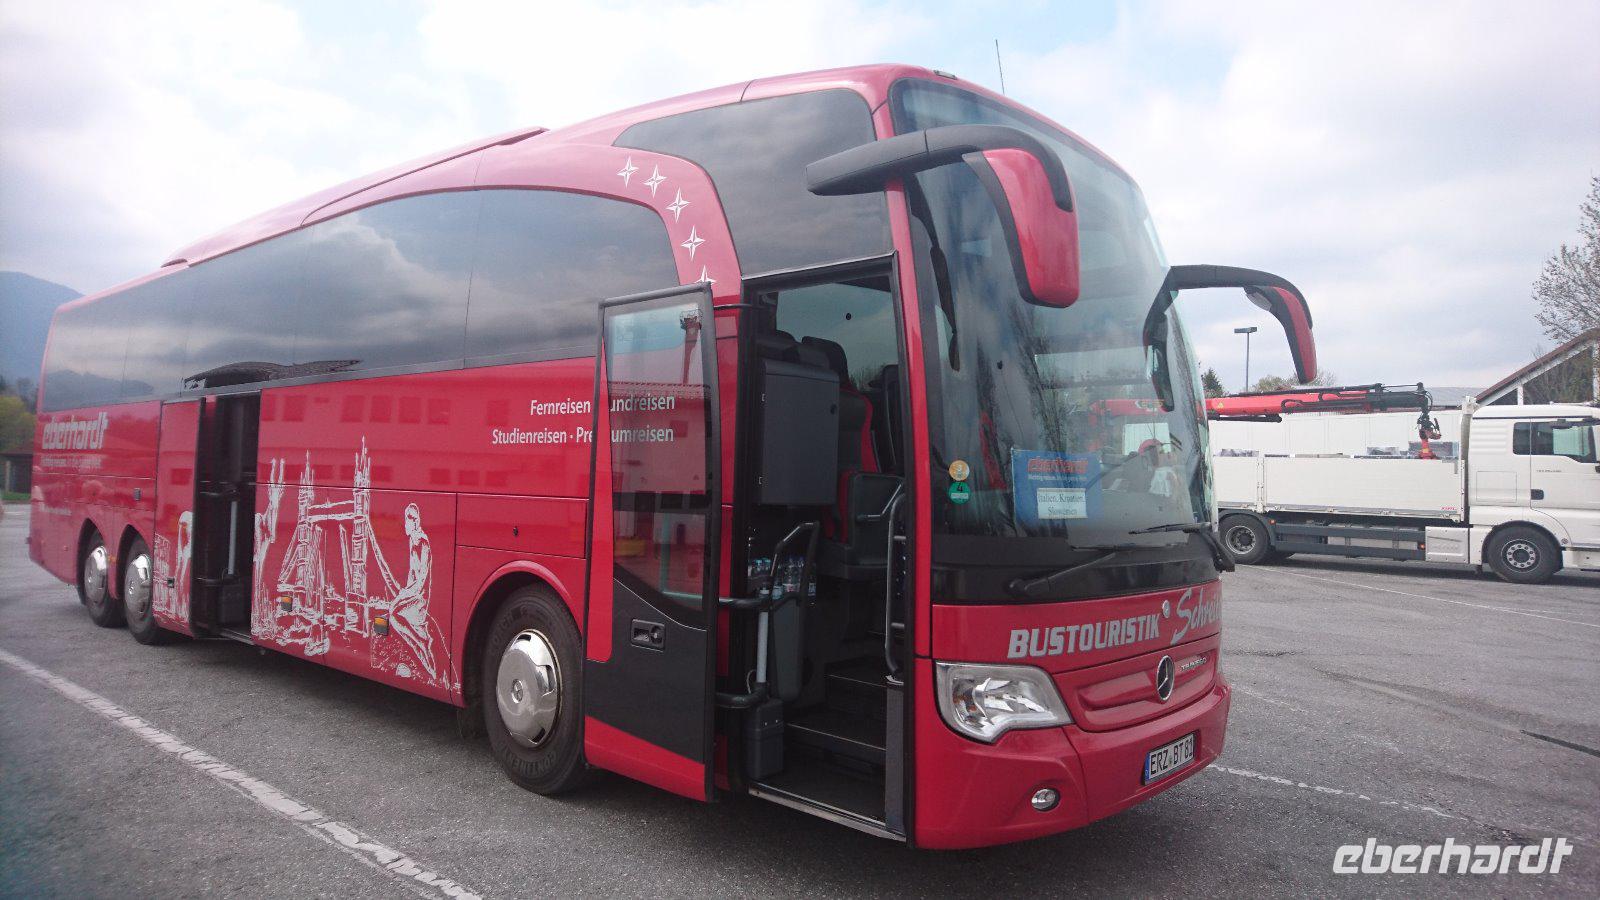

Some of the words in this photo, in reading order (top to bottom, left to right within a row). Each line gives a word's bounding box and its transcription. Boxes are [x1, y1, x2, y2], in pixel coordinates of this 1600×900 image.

[530, 397, 591, 416] Fernreisen
[610, 393, 675, 412] undreisen
[492, 427, 567, 445] Studienreisen
[1007, 613, 1160, 659] BUSTOURISTIK
[1151, 749, 1168, 774] ERZ
[1174, 741, 1184, 765] BT
[1185, 737, 1193, 759] 81
